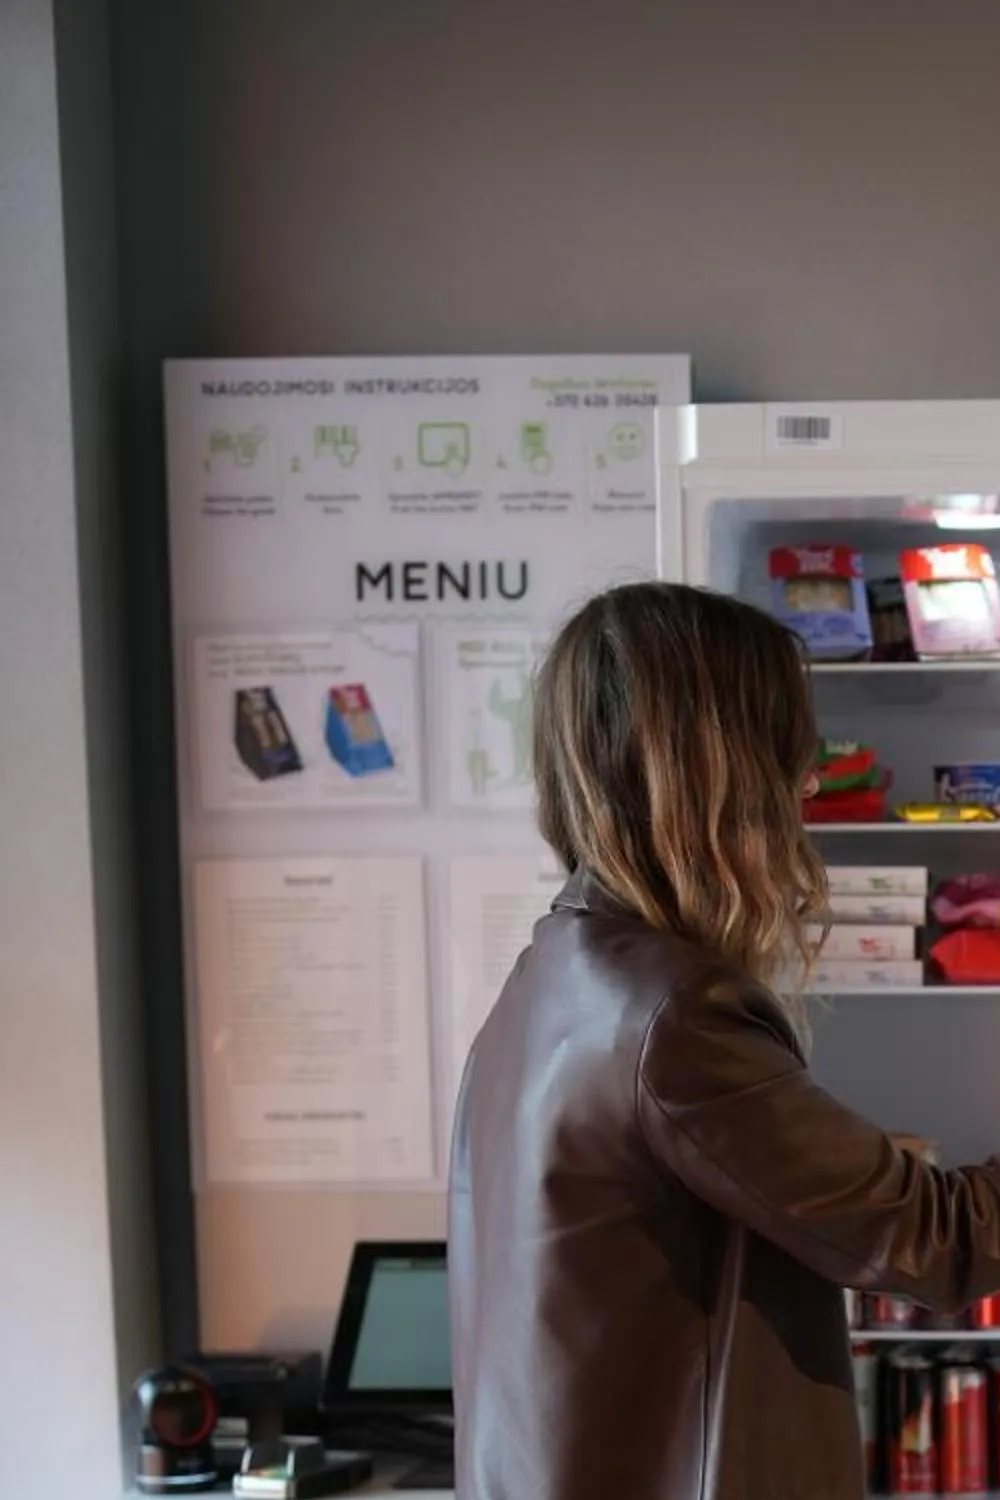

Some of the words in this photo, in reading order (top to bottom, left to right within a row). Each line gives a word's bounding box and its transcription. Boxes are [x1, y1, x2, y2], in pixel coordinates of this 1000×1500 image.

[200, 379, 335, 397] NAUDOJIMOSI
[344, 378, 480, 396] INSTRUKCIJOS
[355, 561, 529, 602] MENIU
